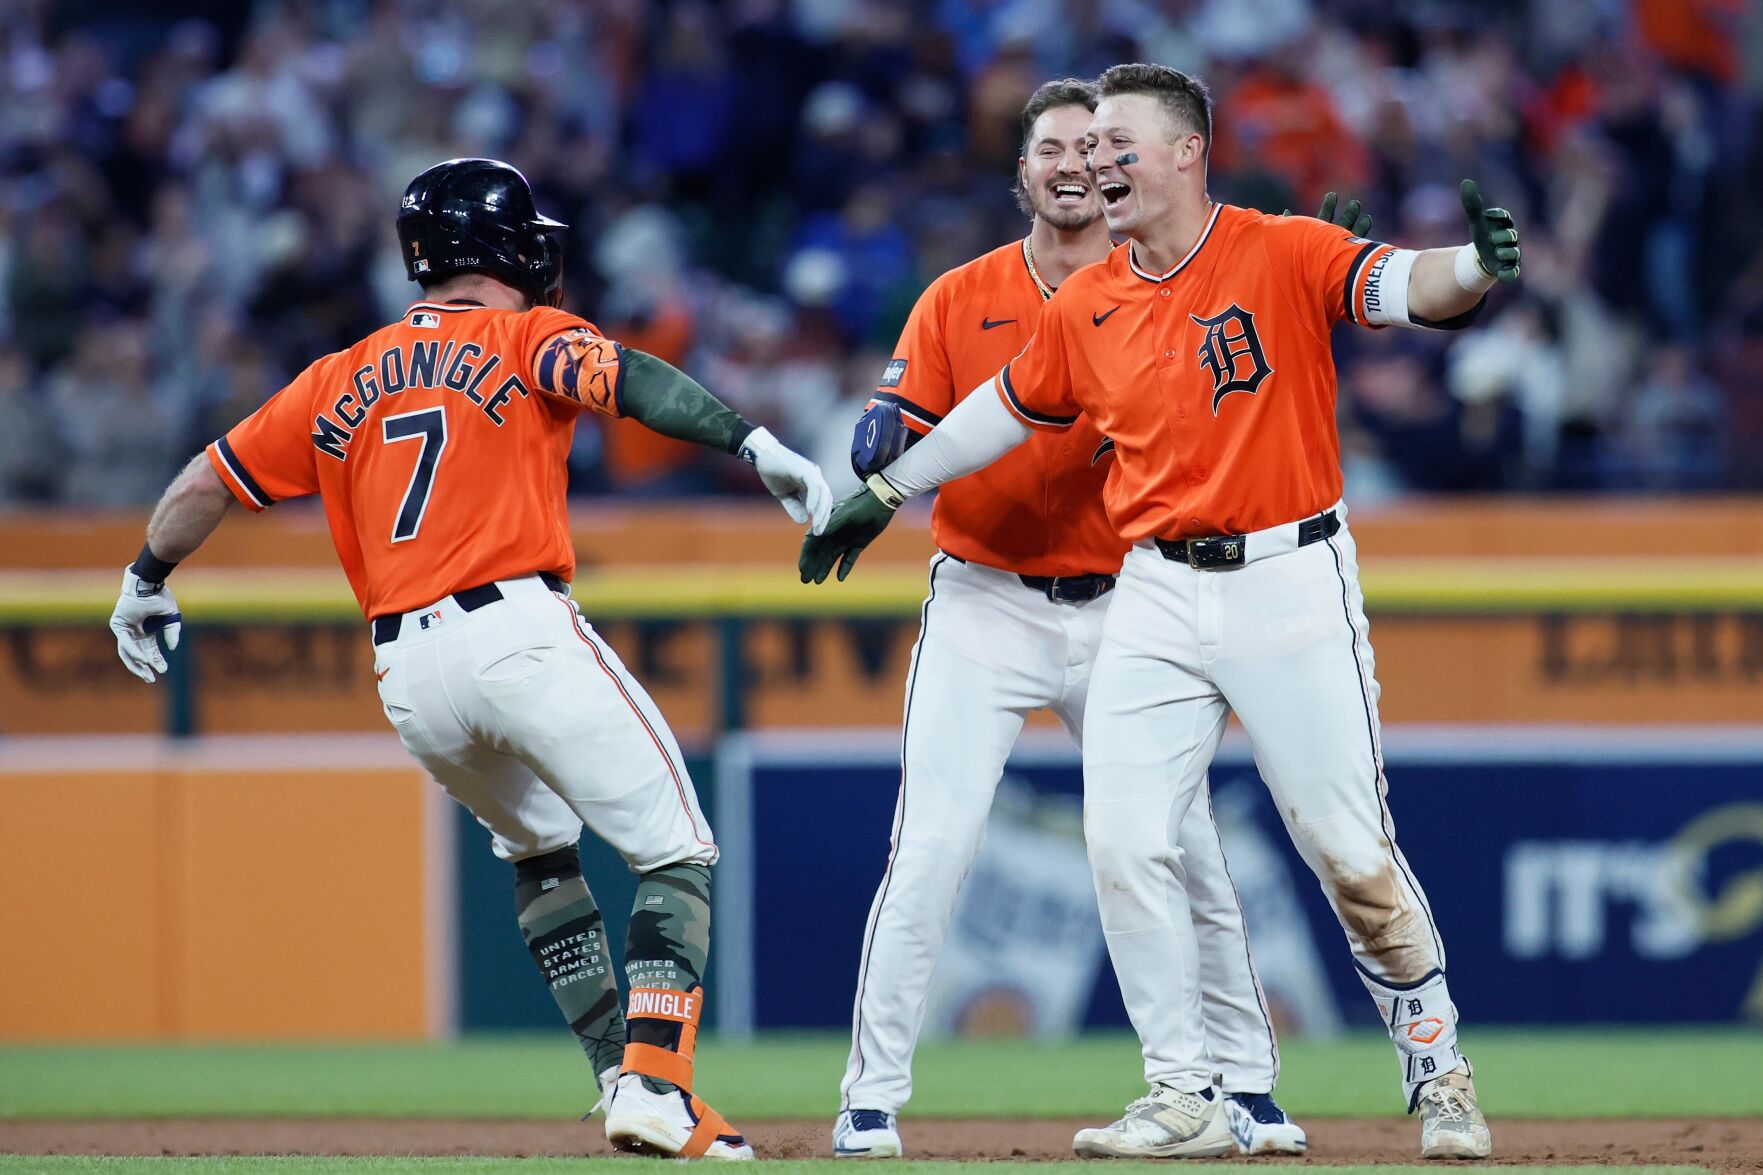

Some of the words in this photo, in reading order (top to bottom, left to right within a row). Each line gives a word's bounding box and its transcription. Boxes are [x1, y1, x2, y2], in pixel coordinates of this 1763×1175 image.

[1188, 302, 1275, 418] D
[382, 405, 448, 544] 7
[1224, 544, 1238, 560] 20
[540, 930, 596, 956] UNITED
[543, 942, 601, 968] STATES
[550, 955, 599, 978] ARMED
[552, 966, 605, 990] FORCES
[624, 959, 675, 974] UNITED
[634, 981, 672, 990] MED
[628, 991, 694, 1019] GONIGLE
